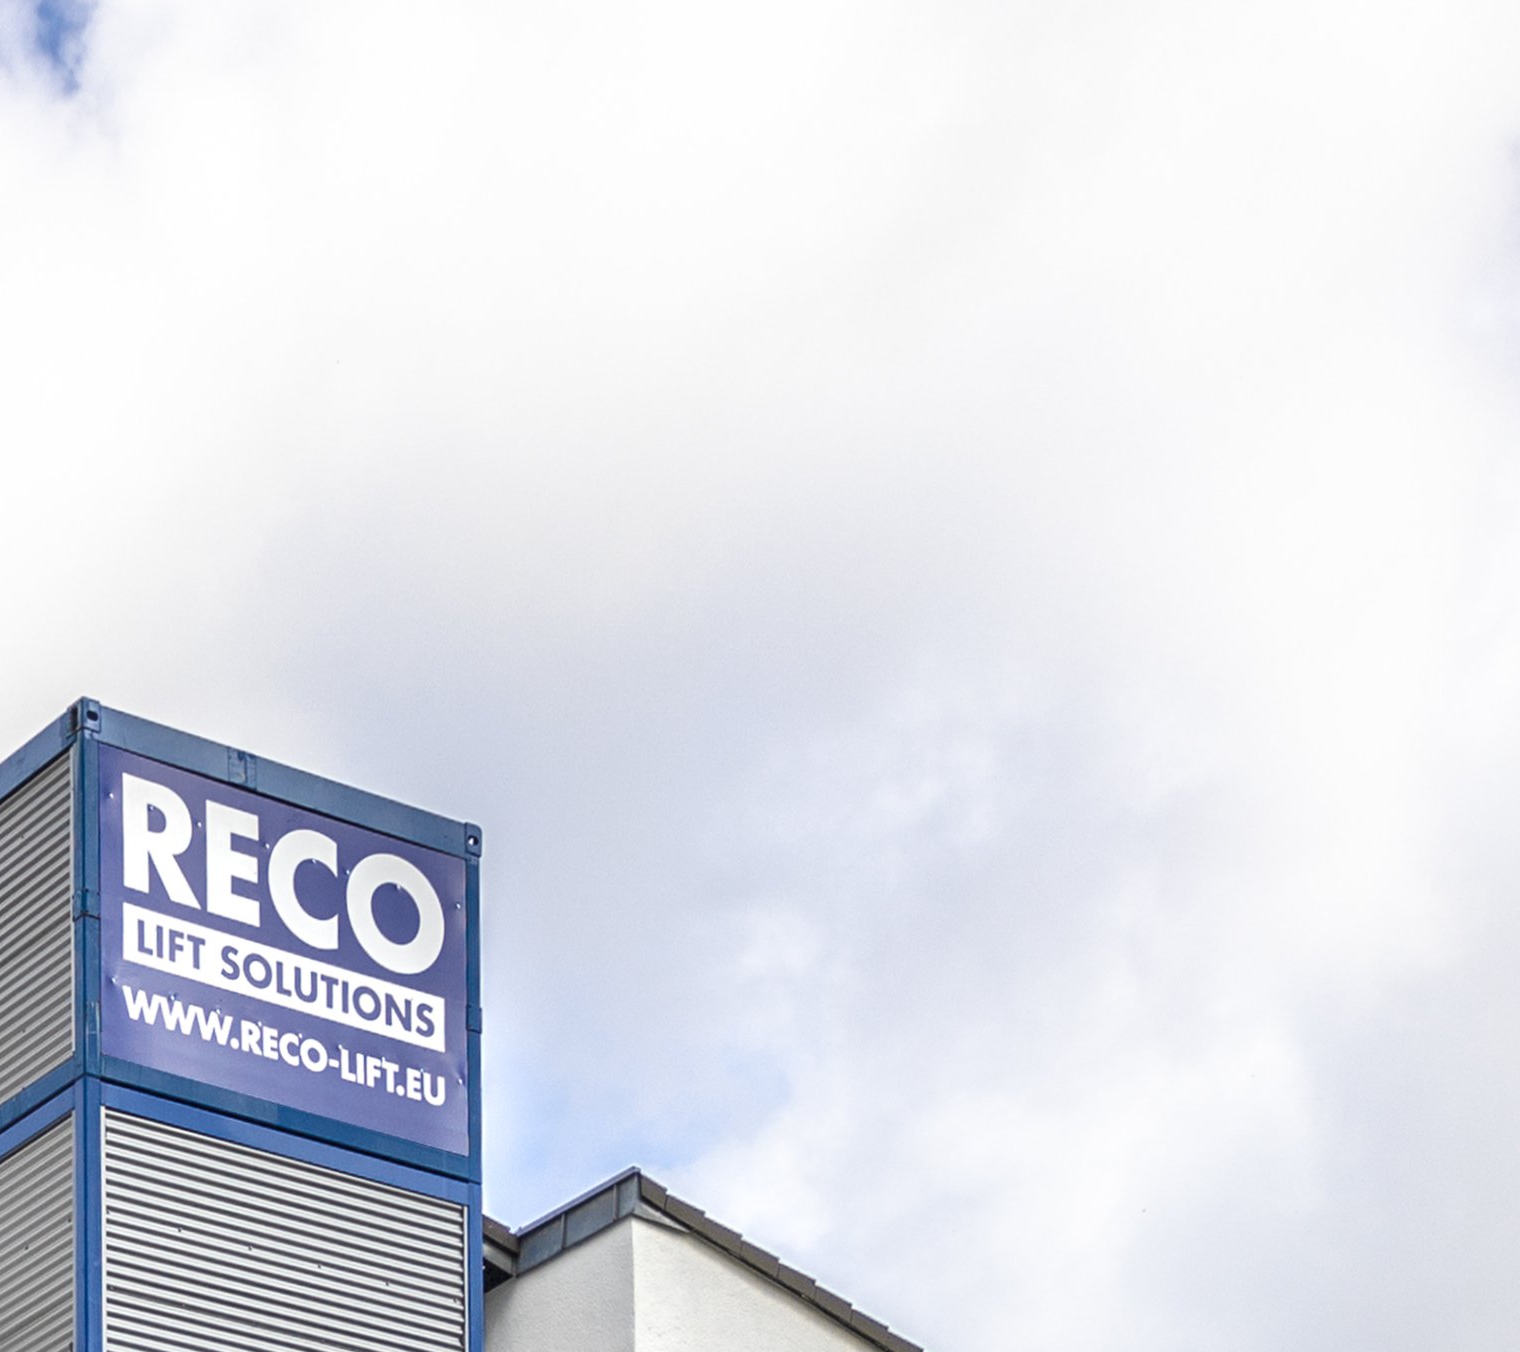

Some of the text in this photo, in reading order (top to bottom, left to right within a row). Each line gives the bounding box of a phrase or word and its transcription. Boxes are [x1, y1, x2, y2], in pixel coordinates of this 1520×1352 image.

[122, 772, 446, 975] RECO
[136, 918, 436, 1039] LIFT SOLUTIONS
[122, 985, 446, 1106] WWW.RECO-LIFT.EU
